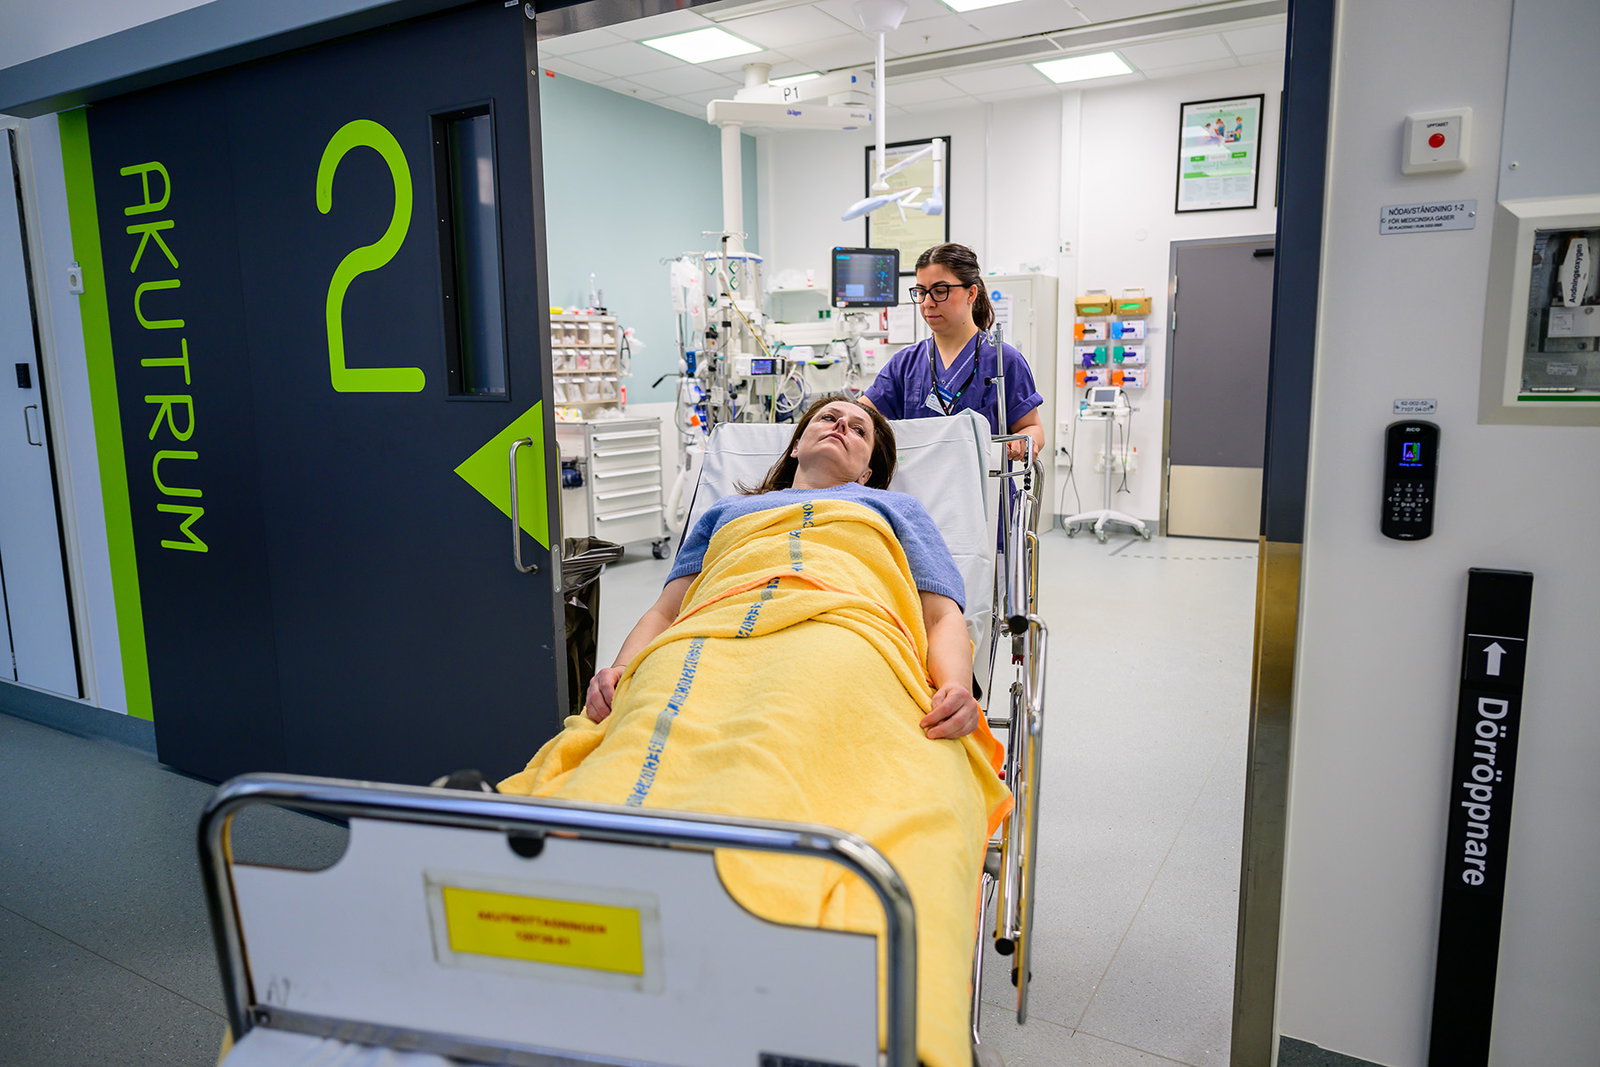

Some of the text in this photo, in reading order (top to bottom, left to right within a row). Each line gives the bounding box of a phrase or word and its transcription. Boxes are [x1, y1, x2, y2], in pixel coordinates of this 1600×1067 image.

[120, 161, 209, 553] AKUTRUM
[316, 119, 426, 393] 2
[1569, 243, 1583, 304] Andningsoxygen
[1461, 696, 1509, 886] Dörröppnare
